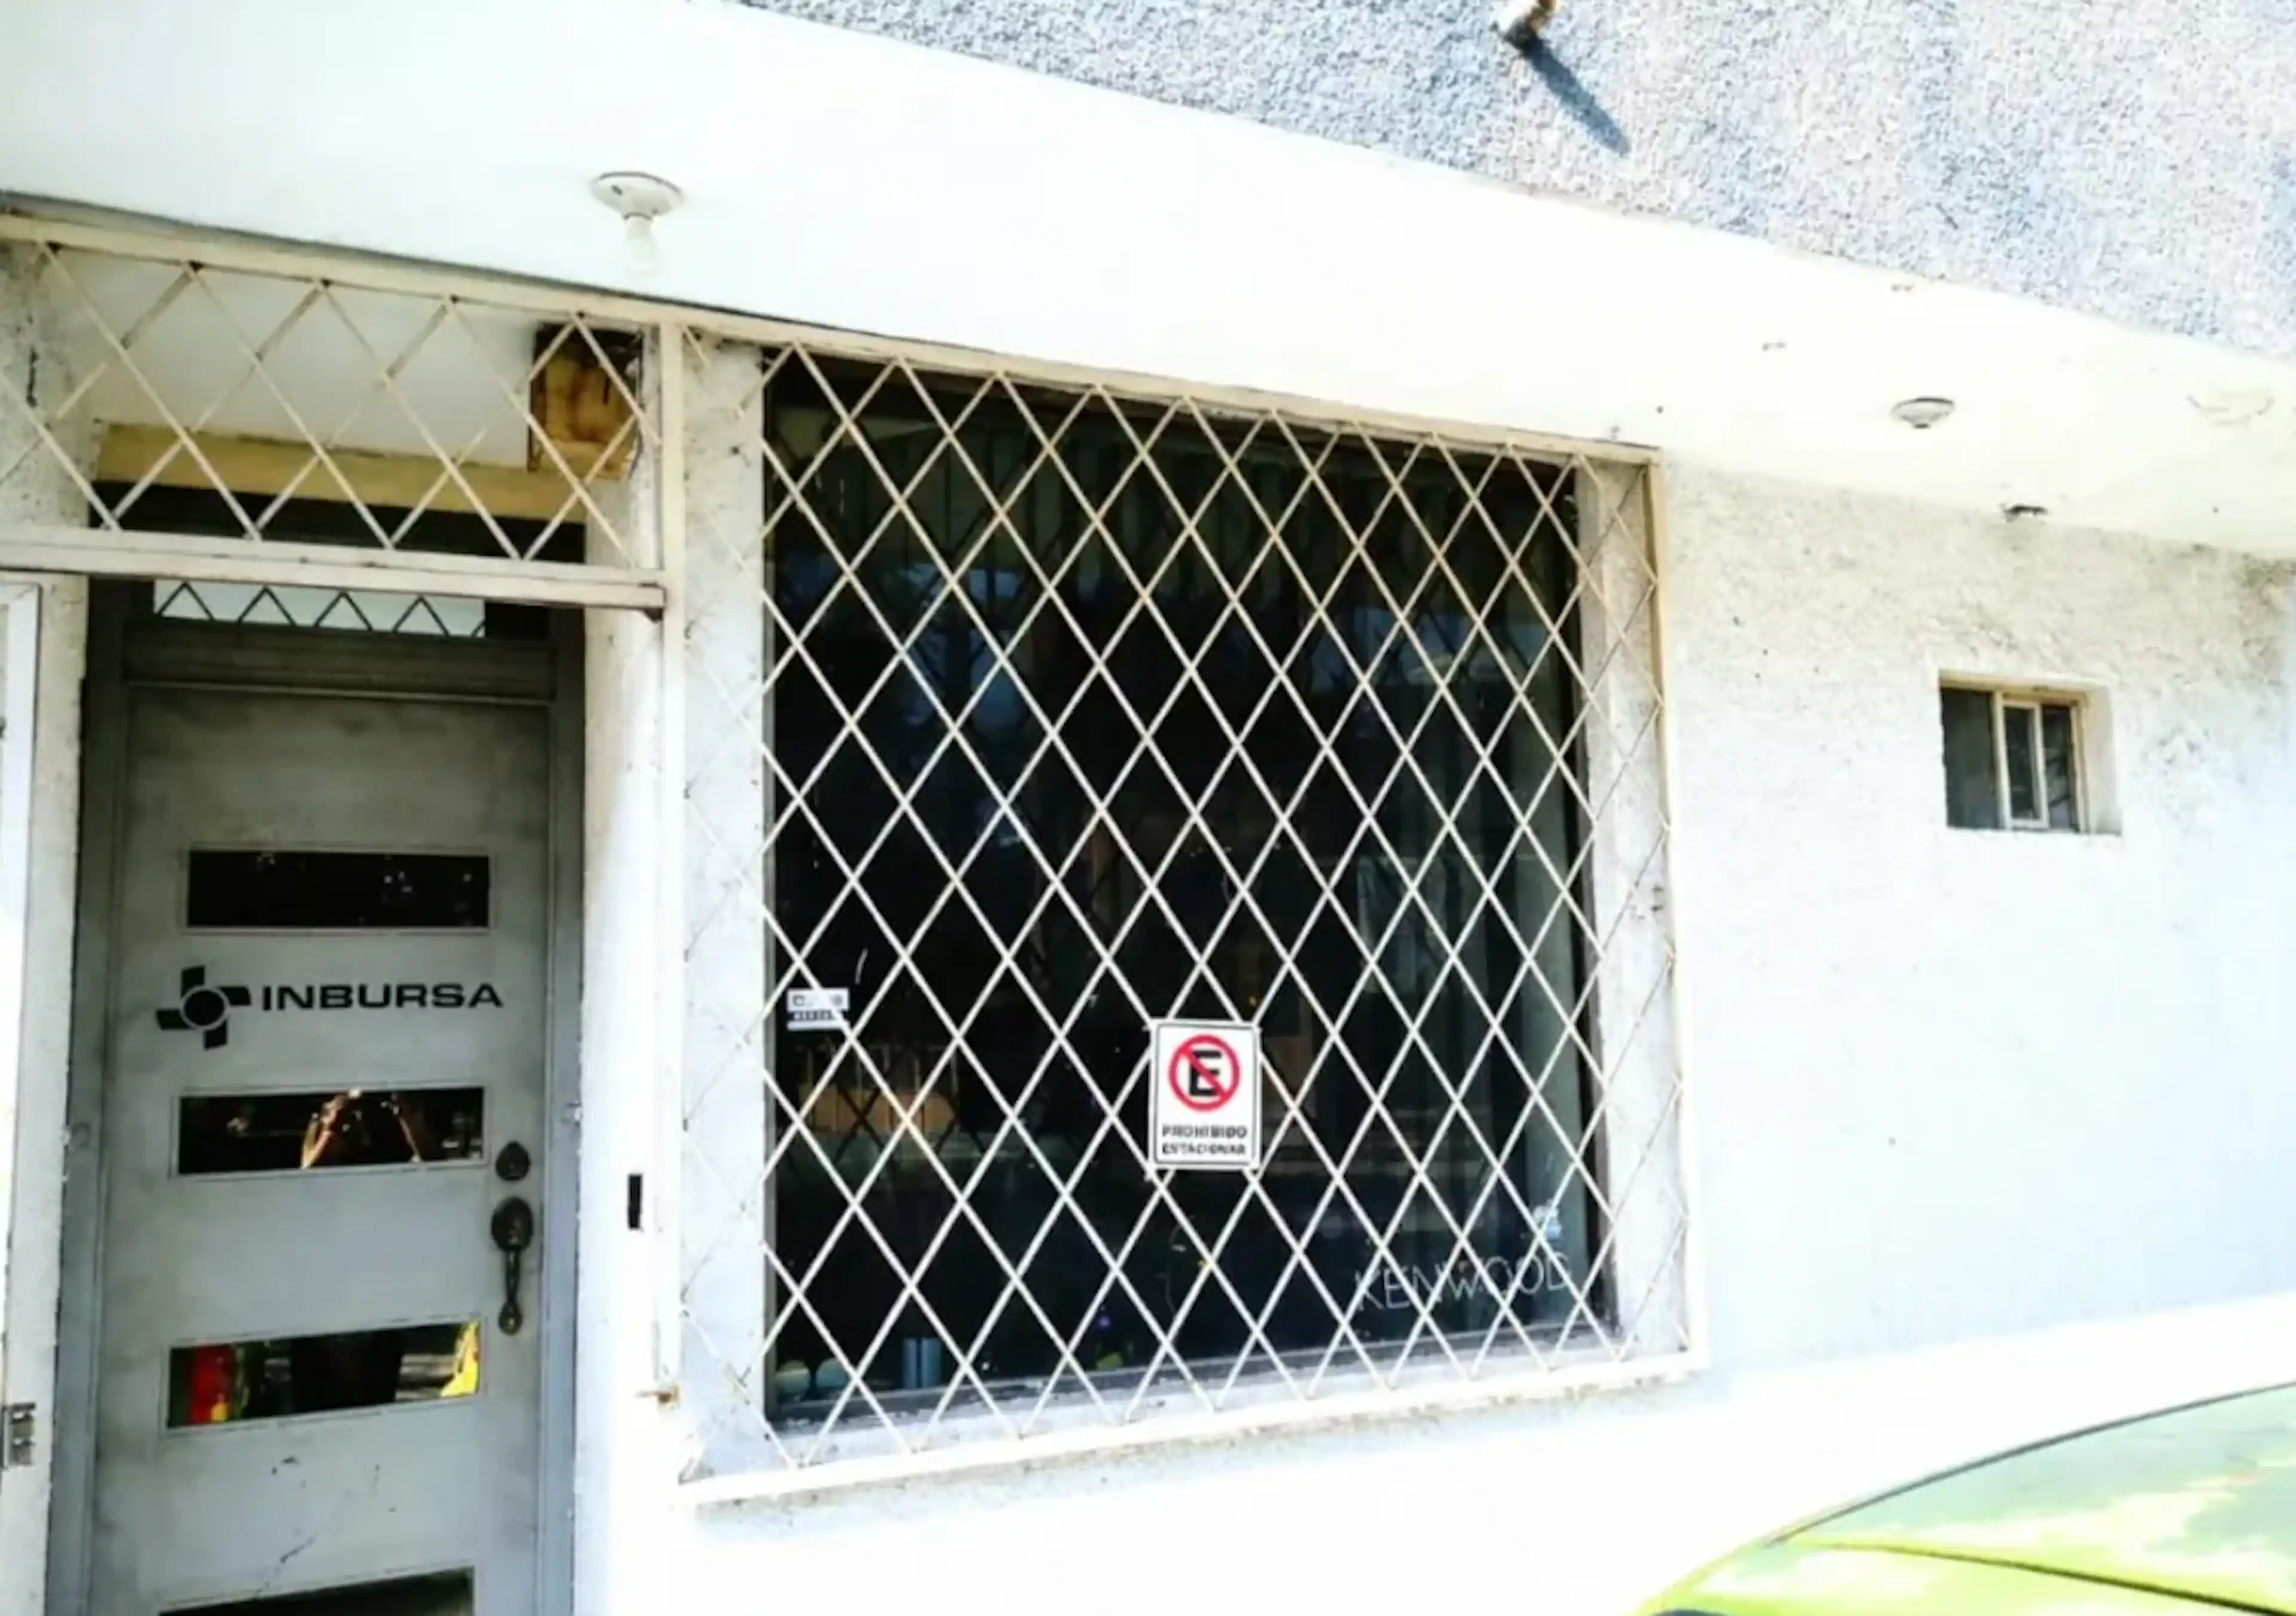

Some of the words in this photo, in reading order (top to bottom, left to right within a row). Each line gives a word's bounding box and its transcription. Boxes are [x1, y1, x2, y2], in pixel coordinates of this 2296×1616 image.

[262, 983, 503, 1011] INBURSA
[1189, 1050, 1222, 1096] E
[1162, 1124, 1248, 1139] PROHIBIDO
[1162, 1142, 1247, 1155] ESTACIONAR
[1354, 1252, 1573, 1311] KENWOOD
